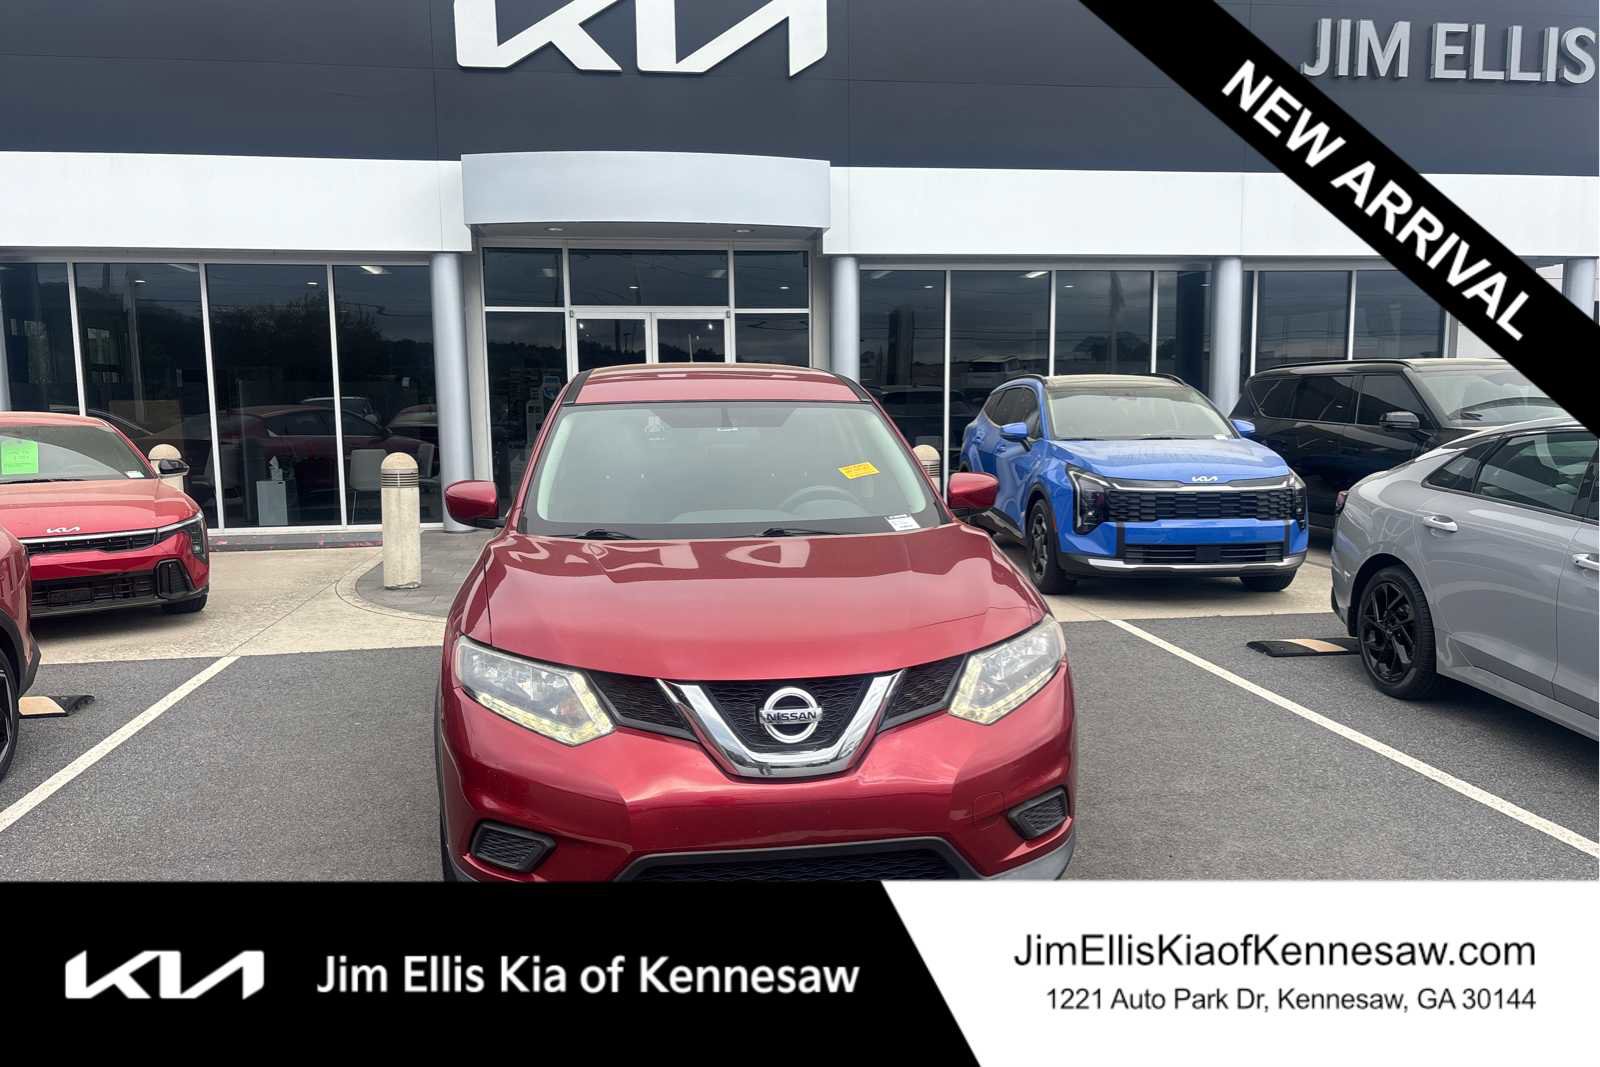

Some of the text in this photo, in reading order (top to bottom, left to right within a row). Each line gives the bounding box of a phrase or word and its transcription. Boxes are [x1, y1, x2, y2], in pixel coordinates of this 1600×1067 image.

[1302, 18, 1596, 84] JIM ELLIS
[766, 711, 817, 721] NISSAN
